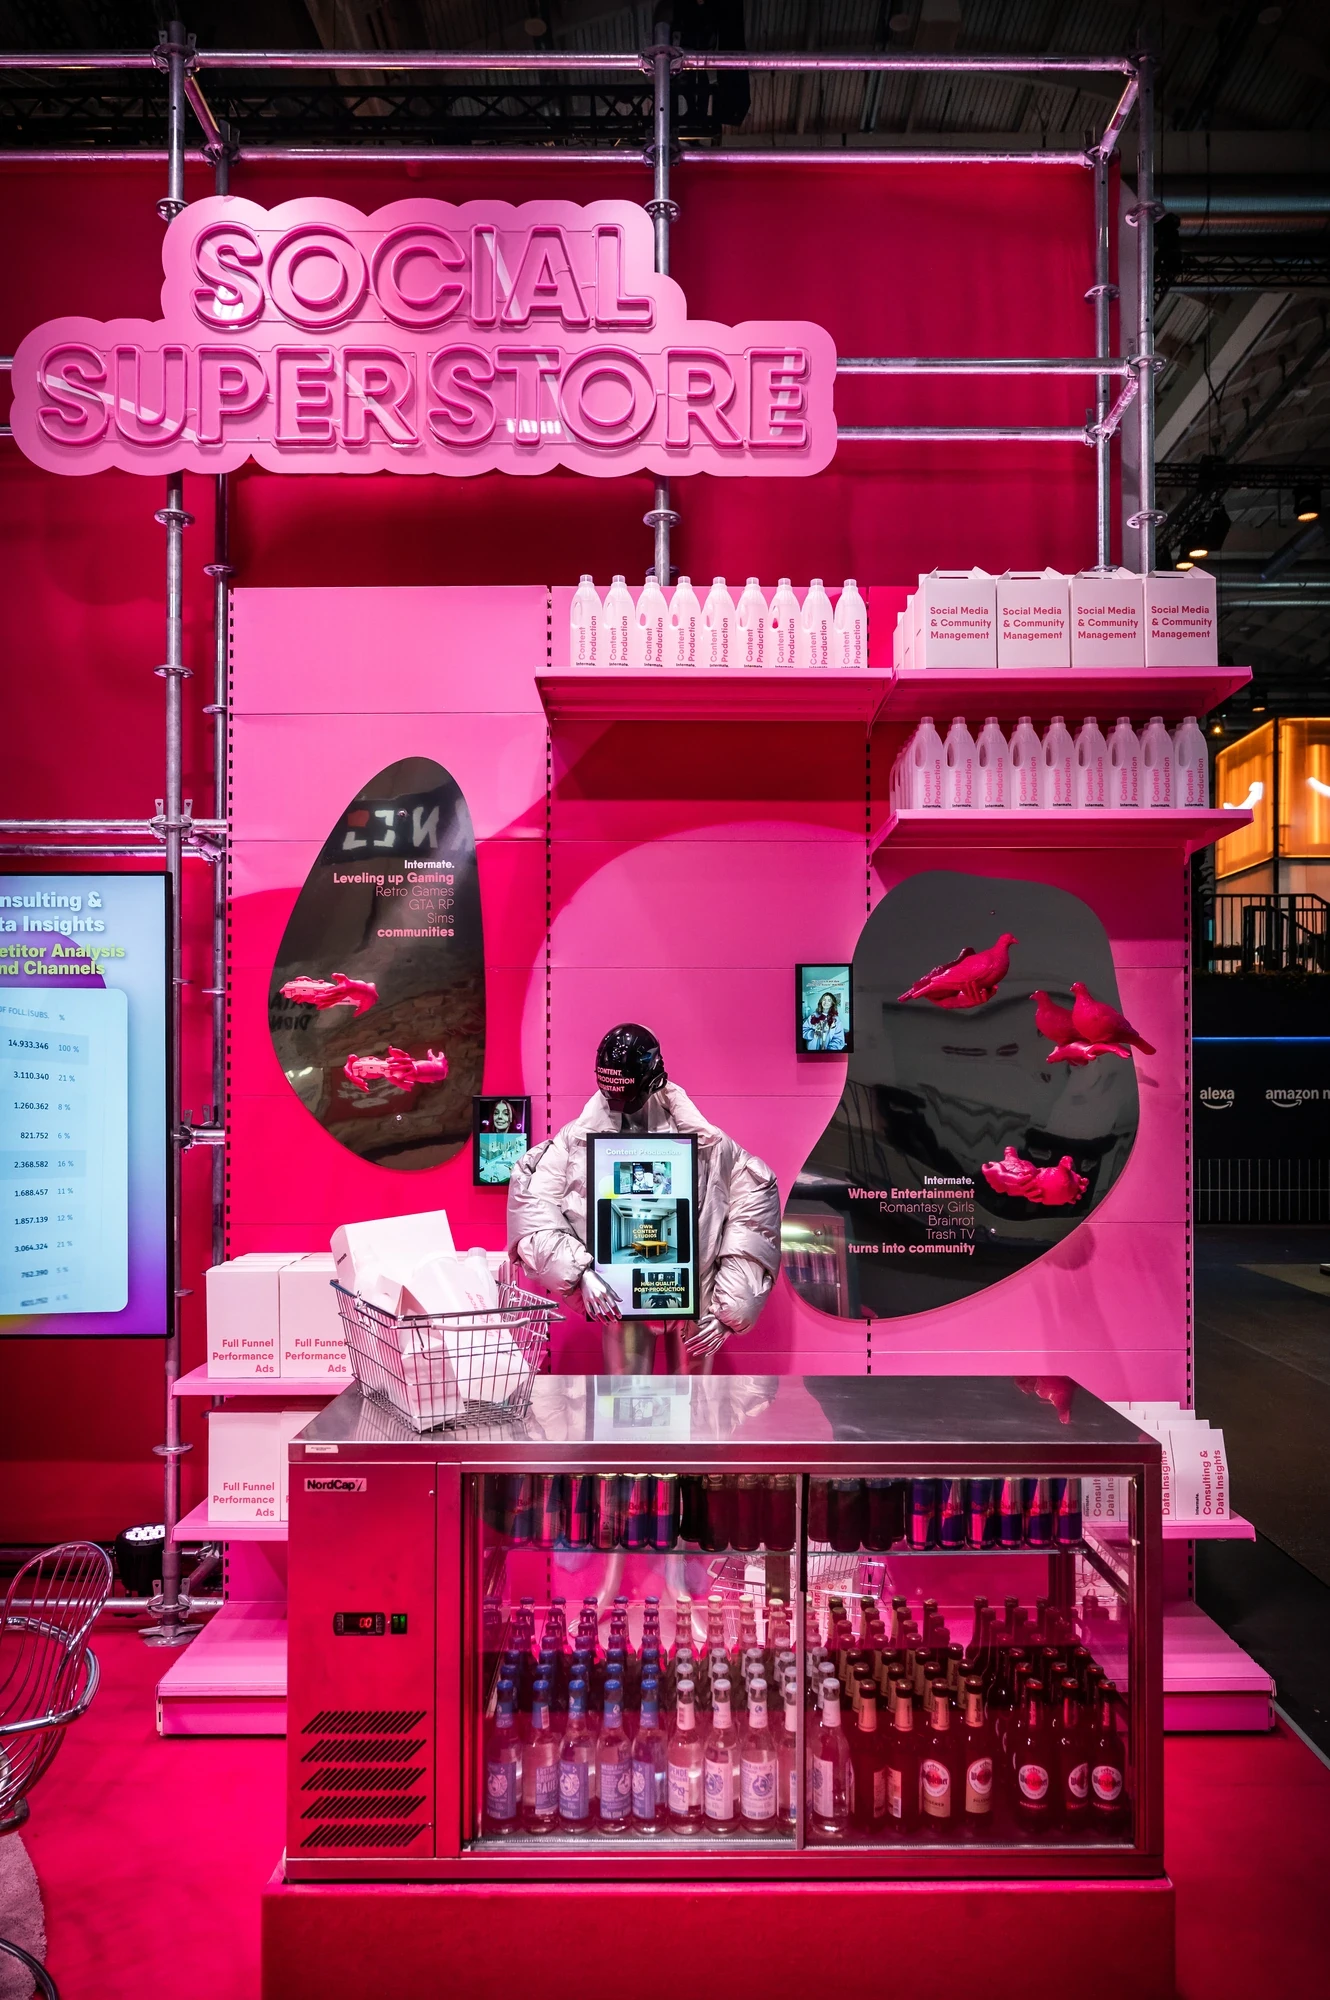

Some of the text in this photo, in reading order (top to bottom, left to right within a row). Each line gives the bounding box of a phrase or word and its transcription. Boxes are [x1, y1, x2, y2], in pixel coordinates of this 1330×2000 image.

[192, 222, 658, 330] SOCIAL
[37, 343, 810, 448] SUPERSTORE
[930, 606, 989, 616] Social Media
[1003, 606, 1062, 616] Social Media
[1077, 606, 1136, 616] Social Media
[1151, 605, 1209, 615] Social Media
[931, 618, 991, 629] & Community
[1003, 618, 1064, 629] & Community
[1078, 618, 1138, 628] & Community
[1152, 617, 1212, 628] & Community
[931, 631, 989, 640] Management
[1004, 631, 1062, 641] Management
[1078, 631, 1136, 640] Management
[1152, 630, 1210, 640] Management
[404, 860, 455, 869] Intermate.
[333, 872, 454, 885] Leveling up Gaming
[376, 886, 454, 896] Retro Games
[0, 891, 102, 911] nsulting &
[409, 899, 454, 910] GTA RP
[427, 912, 454, 924] Sims
[0, 916, 105, 935] ta Insights
[377, 926, 454, 937] communities
[0, 944, 125, 961] etitor Analysis
[0, 961, 105, 975] nd Channels
[8, 1039, 49, 1050] 14.933.346
[13, 1071, 49, 1080] 3.110.340
[597, 1067, 622, 1076] CONTENT
[1200, 1086, 1235, 1100] alexa
[1265, 1089, 1319, 1100] amazon
[14, 1102, 49, 1110] 1.260.362
[924, 1176, 975, 1185] Intermate.
[14, 1188, 49, 1197] 1.688.457
[848, 1188, 974, 1199] Where Entertainment
[879, 1201, 974, 1214] Romantasy Girls
[14, 1216, 48, 1225] 1.857.139
[929, 1215, 974, 1226] Brainrot
[926, 1229, 975, 1240] Trash TV
[15, 1243, 48, 1252] 3.064.324
[848, 1243, 975, 1255] turns into community
[222, 1338, 274, 1348] Full Funnel
[295, 1338, 346, 1348] Full Funnel
[213, 1351, 274, 1361] Performance
[285, 1351, 346, 1361] Performance
[255, 1364, 274, 1374] Ads
[328, 1364, 347, 1373] Ads
[223, 1482, 274, 1491] Full Funnel
[307, 1480, 355, 1491] NordCap
[1200, 1450, 1212, 1515] Consulting &
[1214, 1450, 1224, 1515] Data Insights
[213, 1495, 274, 1504] Performance
[1093, 1478, 1101, 1517] Consult
[1106, 1478, 1114, 1516] Data Ins
[1162, 1493, 1170, 1515] Data
[256, 1508, 274, 1517] Ads
